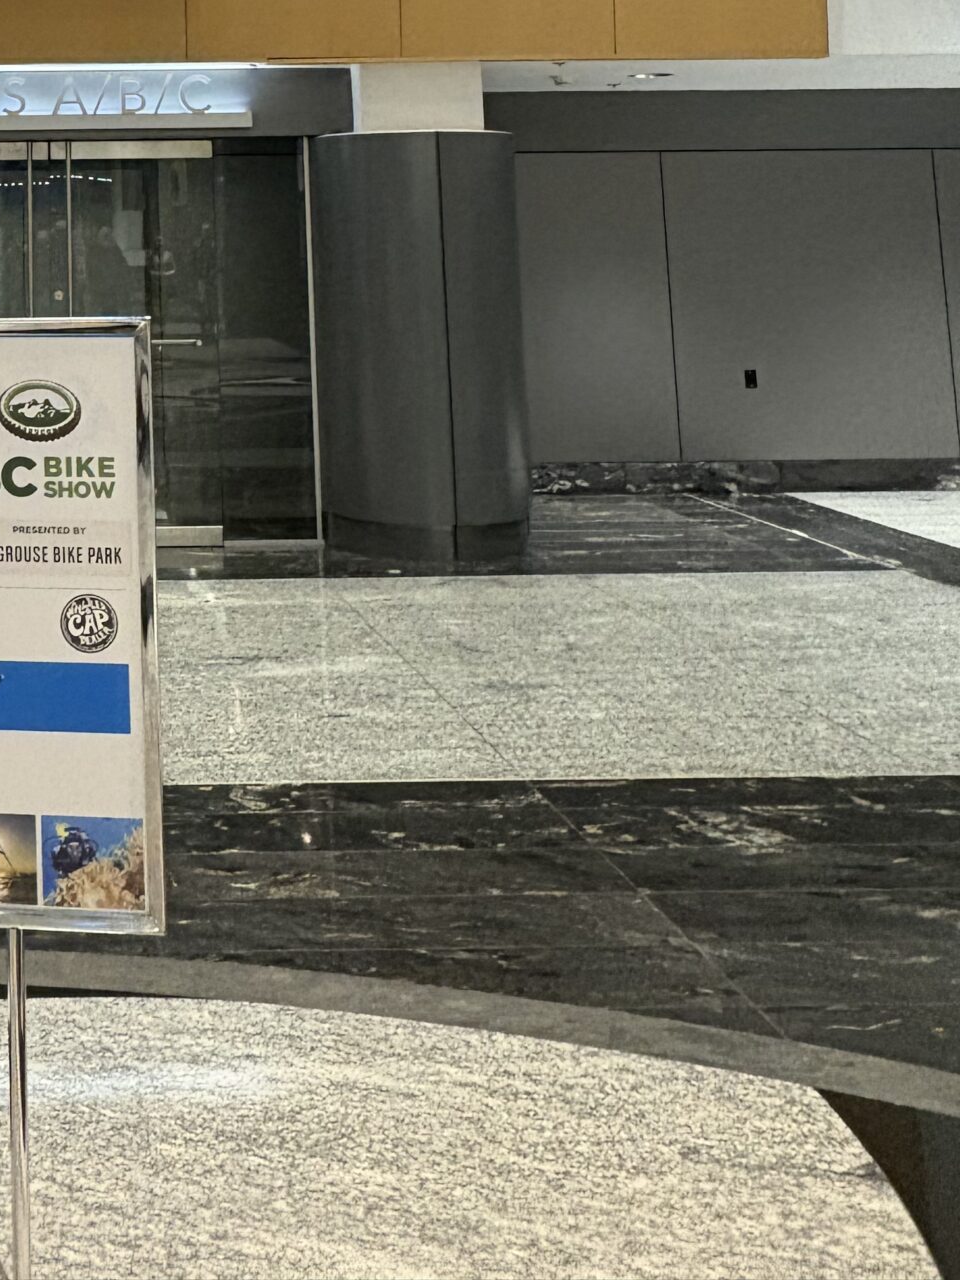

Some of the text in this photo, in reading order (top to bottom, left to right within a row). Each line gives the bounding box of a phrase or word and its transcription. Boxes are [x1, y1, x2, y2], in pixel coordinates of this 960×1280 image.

[51, 73, 212, 116] A/B/C
[43, 456, 116, 478] BIKE
[43, 480, 116, 499] SHOW
[12, 525, 87, 536] PRESENTED BY
[53, 546, 83, 564] BIKE
[88, 547, 123, 565] PARK
[67, 609, 110, 637] CAP
